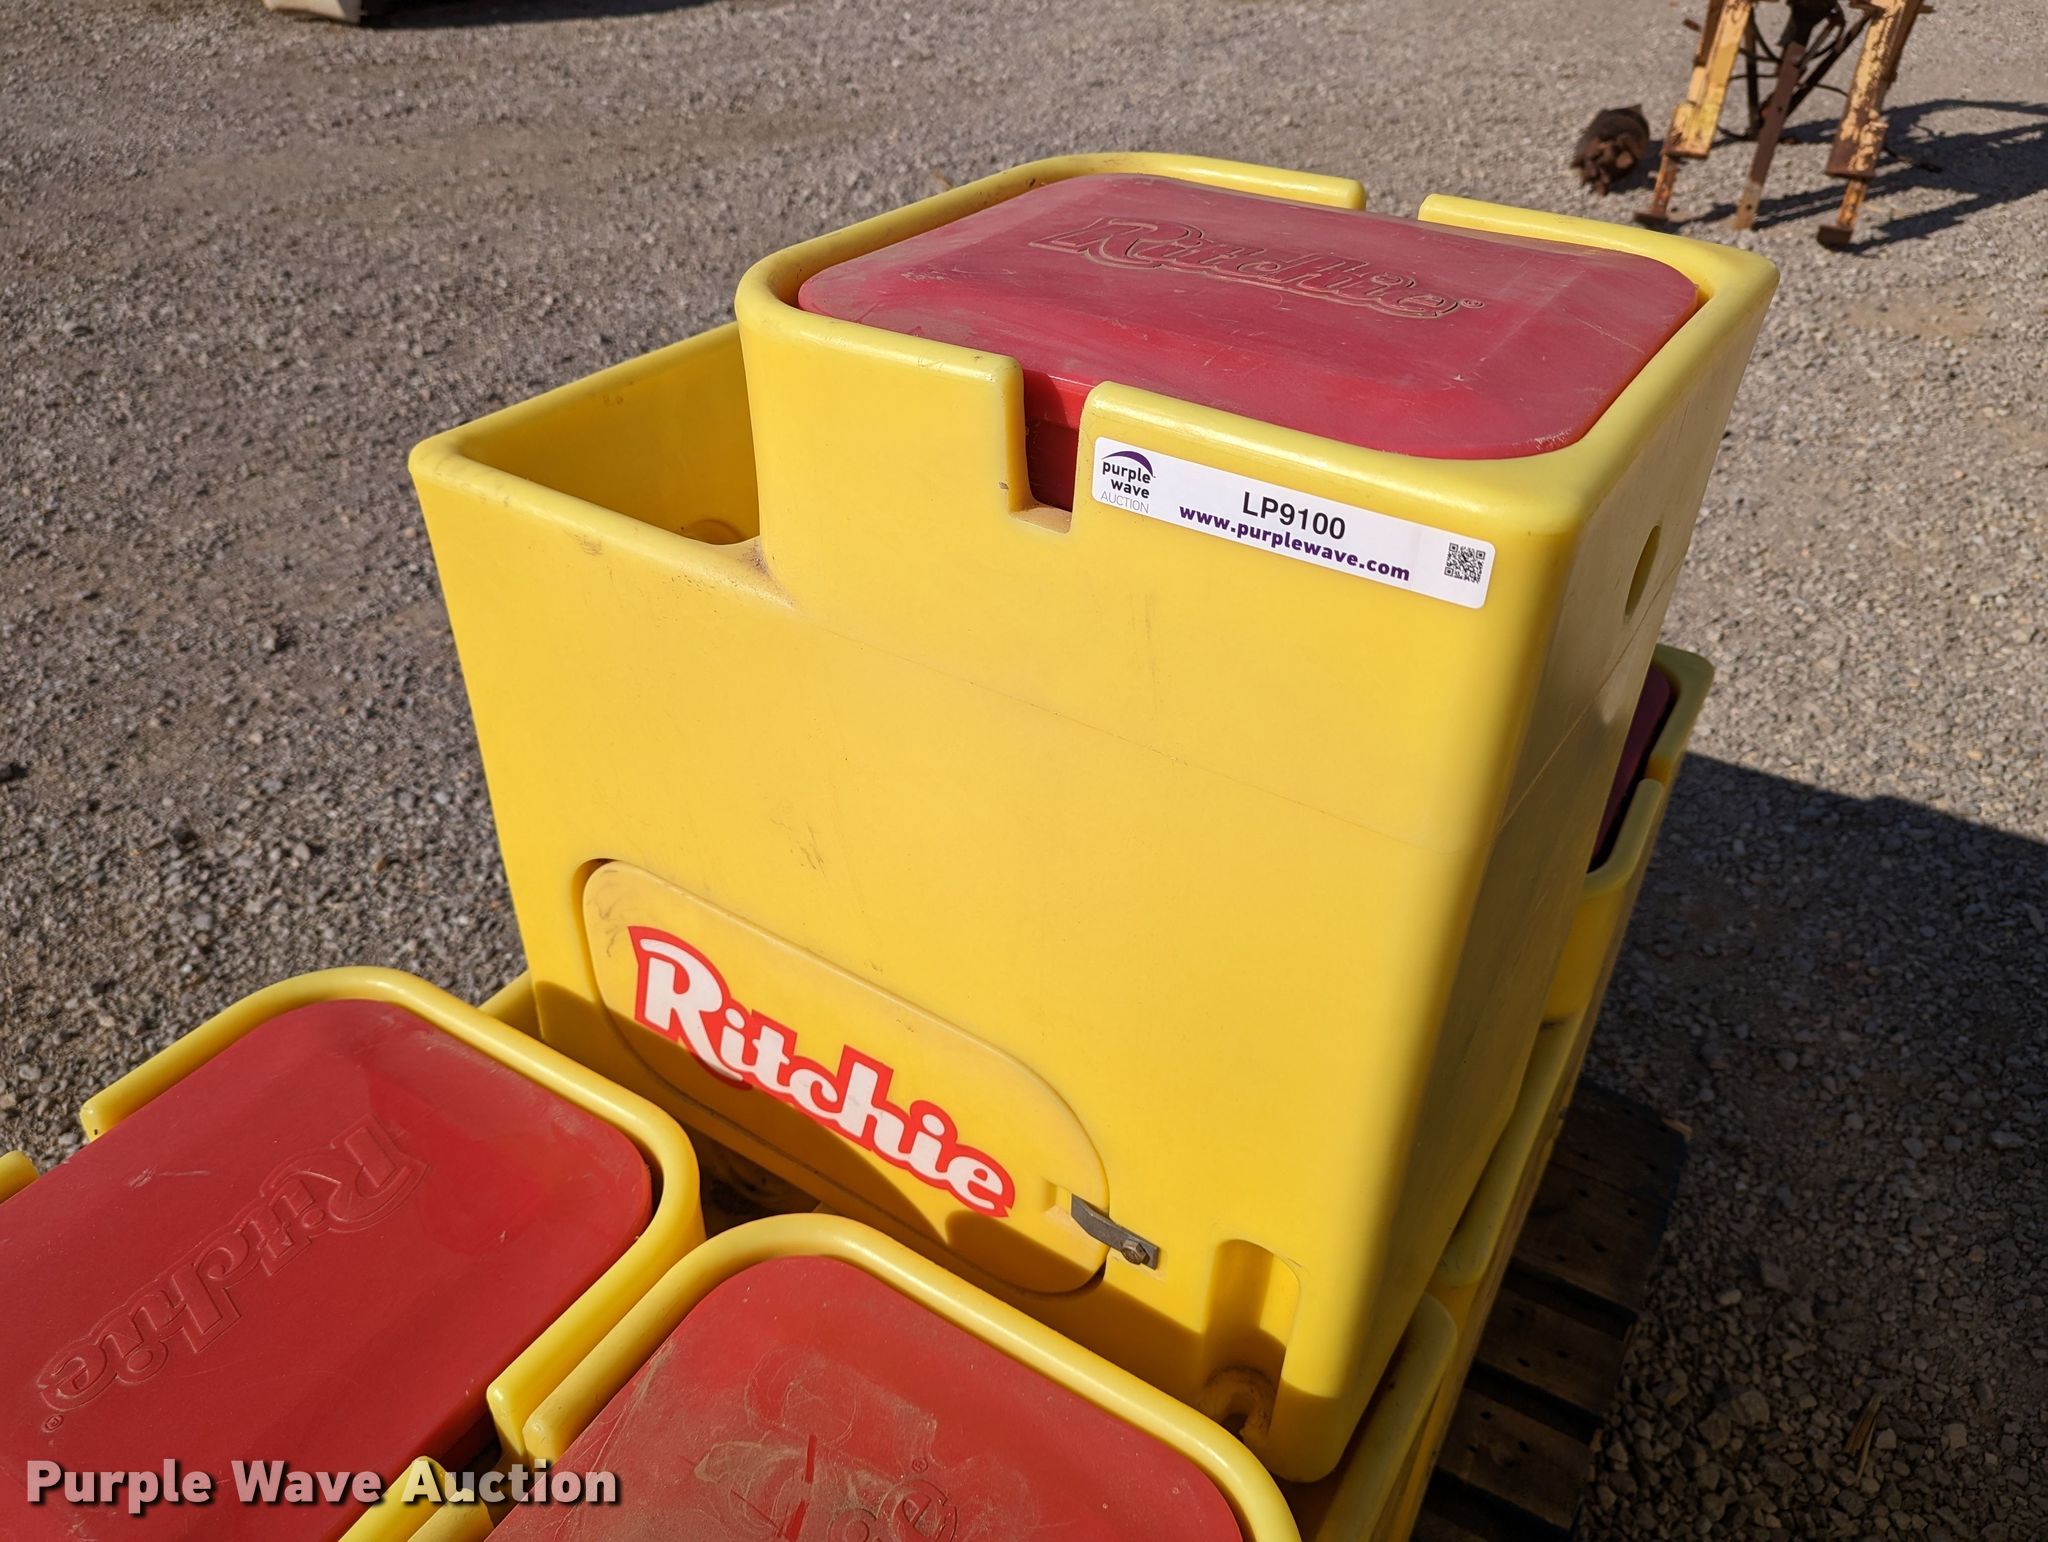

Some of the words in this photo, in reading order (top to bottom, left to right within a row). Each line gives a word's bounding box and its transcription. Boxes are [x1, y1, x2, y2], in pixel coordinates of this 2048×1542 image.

[1101, 459, 1152, 485] purple
[1110, 478, 1150, 499] wave
[1100, 490, 1150, 514] AUCTION
[1242, 491, 1346, 540] LP9100
[1179, 505, 1410, 582] www.purplewave.com
[628, 926, 1016, 1218] Ritchie
